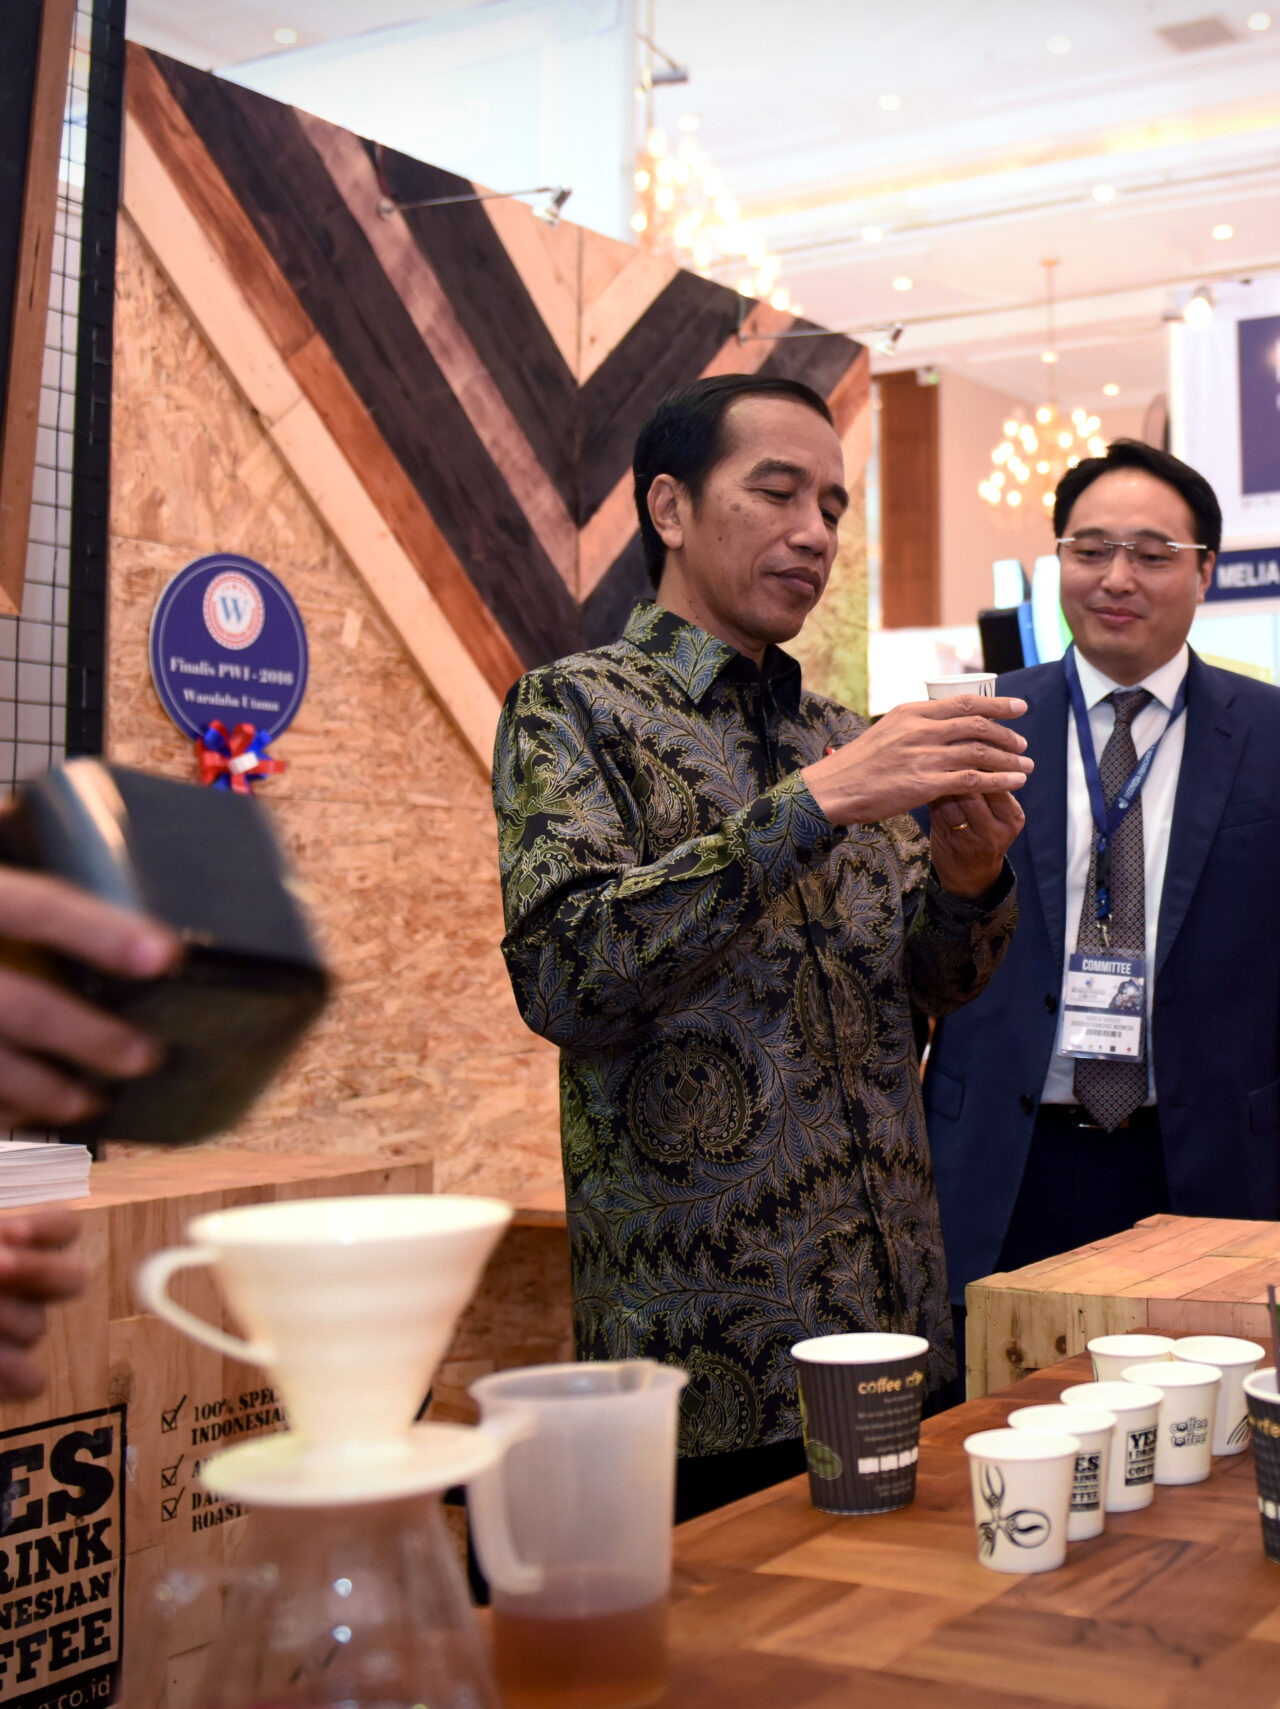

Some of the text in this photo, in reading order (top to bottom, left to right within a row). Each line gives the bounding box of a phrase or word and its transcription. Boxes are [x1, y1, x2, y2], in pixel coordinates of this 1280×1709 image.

[170, 656, 216, 677] Finalis
[218, 662, 250, 681] PWI
[1082, 959, 1132, 975] COMMITTEE
[858, 1376, 902, 1395] coffee
[194, 1398, 234, 1422] 100%
